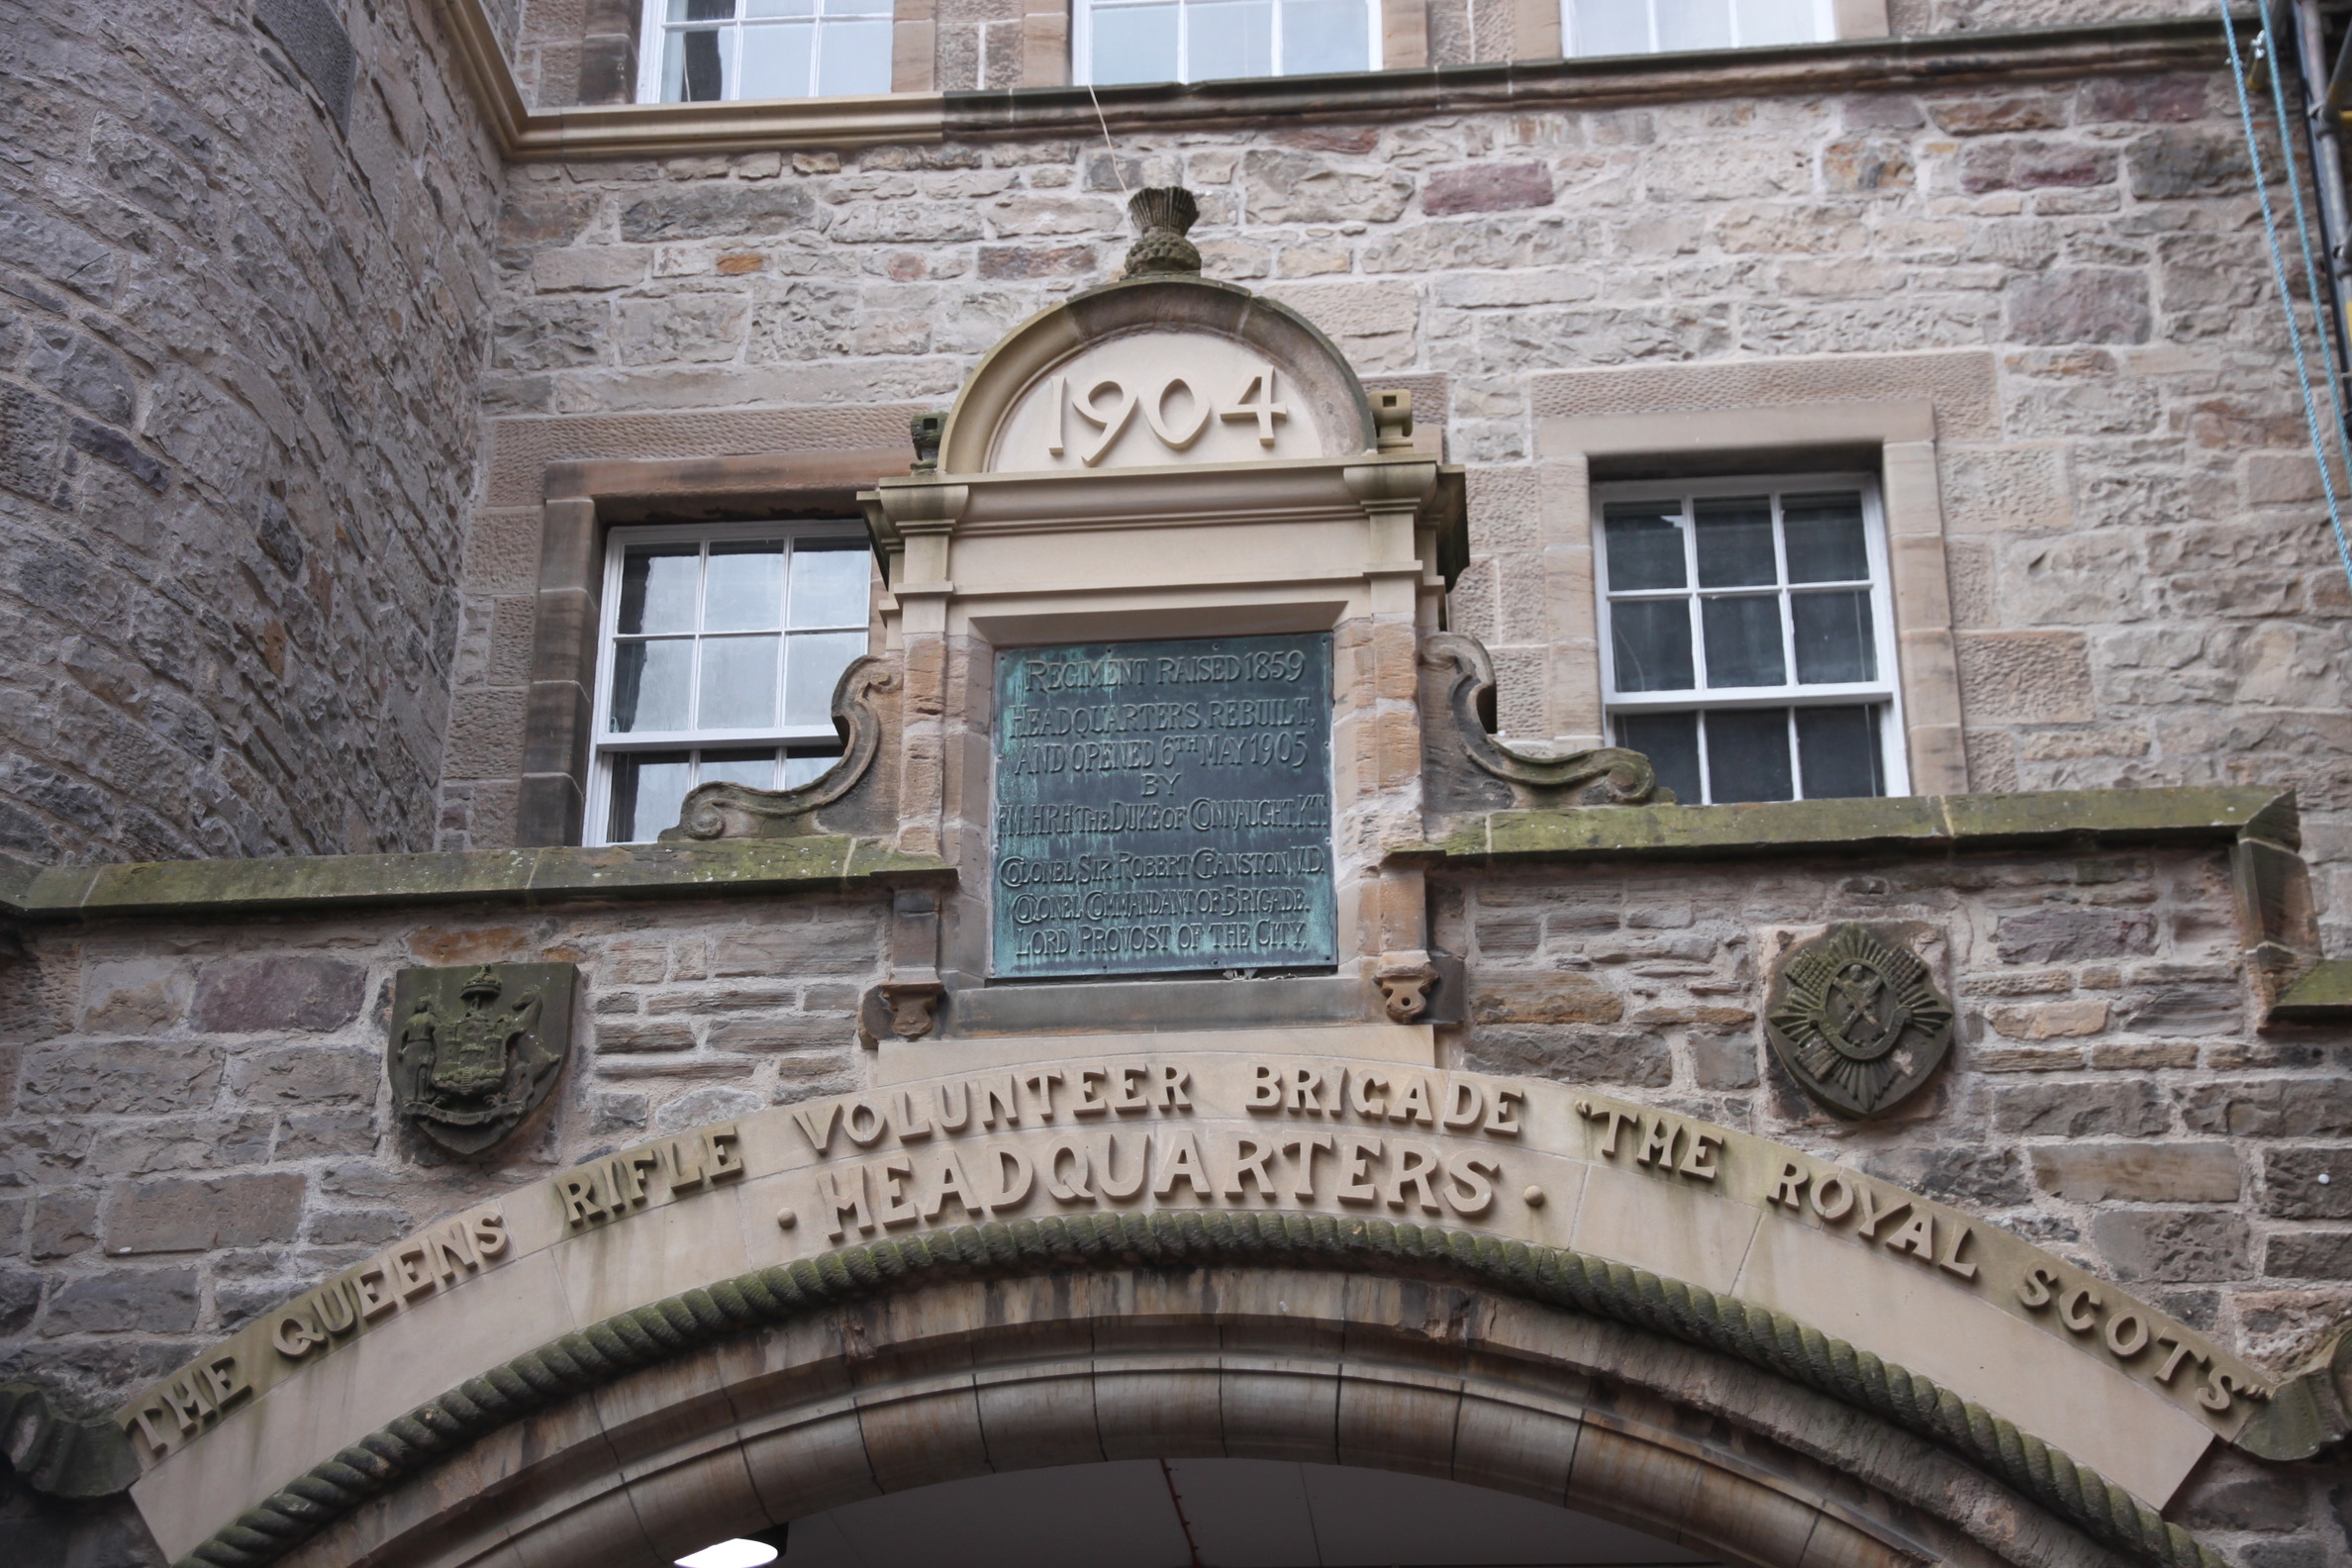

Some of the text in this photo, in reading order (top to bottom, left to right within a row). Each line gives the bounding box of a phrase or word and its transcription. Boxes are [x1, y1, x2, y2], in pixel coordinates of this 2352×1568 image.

[1048, 365, 1288, 467] 1904
[1026, 649, 1306, 693] REGIMENT RAISED 1859
[1009, 701, 1202, 738] HEADQUARTERS
[1014, 742, 1067, 776] AND
[1070, 739, 1156, 772] OPENED
[1200, 734, 1247, 766] MAY
[1249, 731, 1309, 768] 1905
[1139, 772, 1182, 798] BY
[1016, 927, 1071, 957] LORD
[1077, 924, 1172, 955] PROVOST
[1177, 923, 1204, 950] OF
[1209, 921, 1252, 949] THE
[815, 1127, 1505, 1241] HEADQUARTERS
[123, 1355, 253, 1457] THE
[272, 1210, 510, 1359] QUEENS
[556, 1127, 745, 1227] RIFLE
[792, 1060, 1192, 1156] VOLUNTEER
[1243, 1061, 1525, 1136] BRIGADE
[1765, 1160, 1978, 1280] ROYAL
